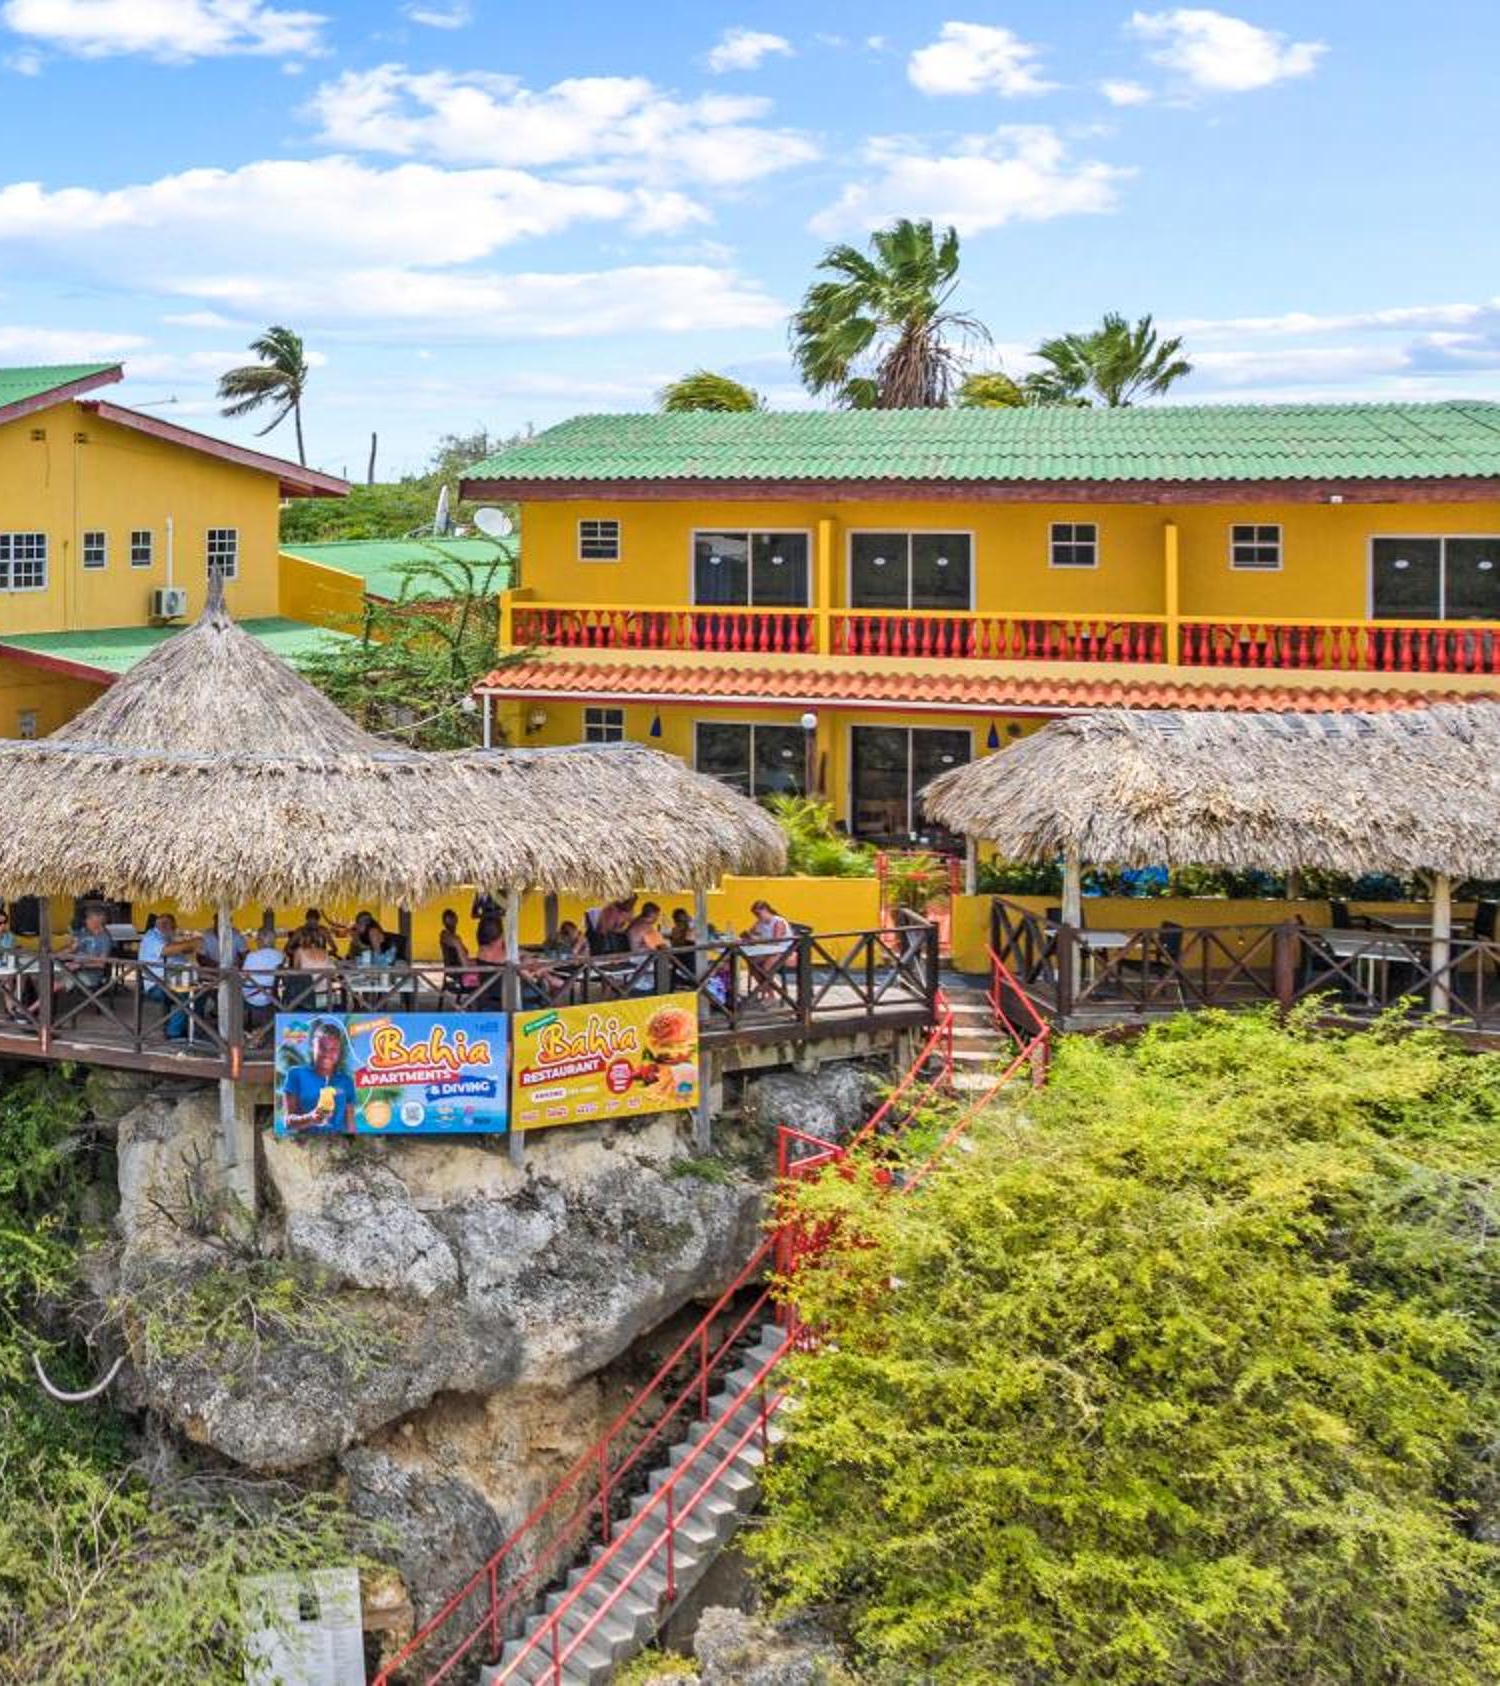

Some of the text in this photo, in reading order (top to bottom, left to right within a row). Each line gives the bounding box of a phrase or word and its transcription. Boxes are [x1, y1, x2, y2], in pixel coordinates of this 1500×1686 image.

[368, 1024, 491, 1071] Bahia
[537, 1014, 637, 1065] Bahia
[361, 1070, 451, 1085] APARTMENTS
[523, 1060, 599, 1085] RESTAURANT
[431, 1081, 490, 1095] & DIVING
